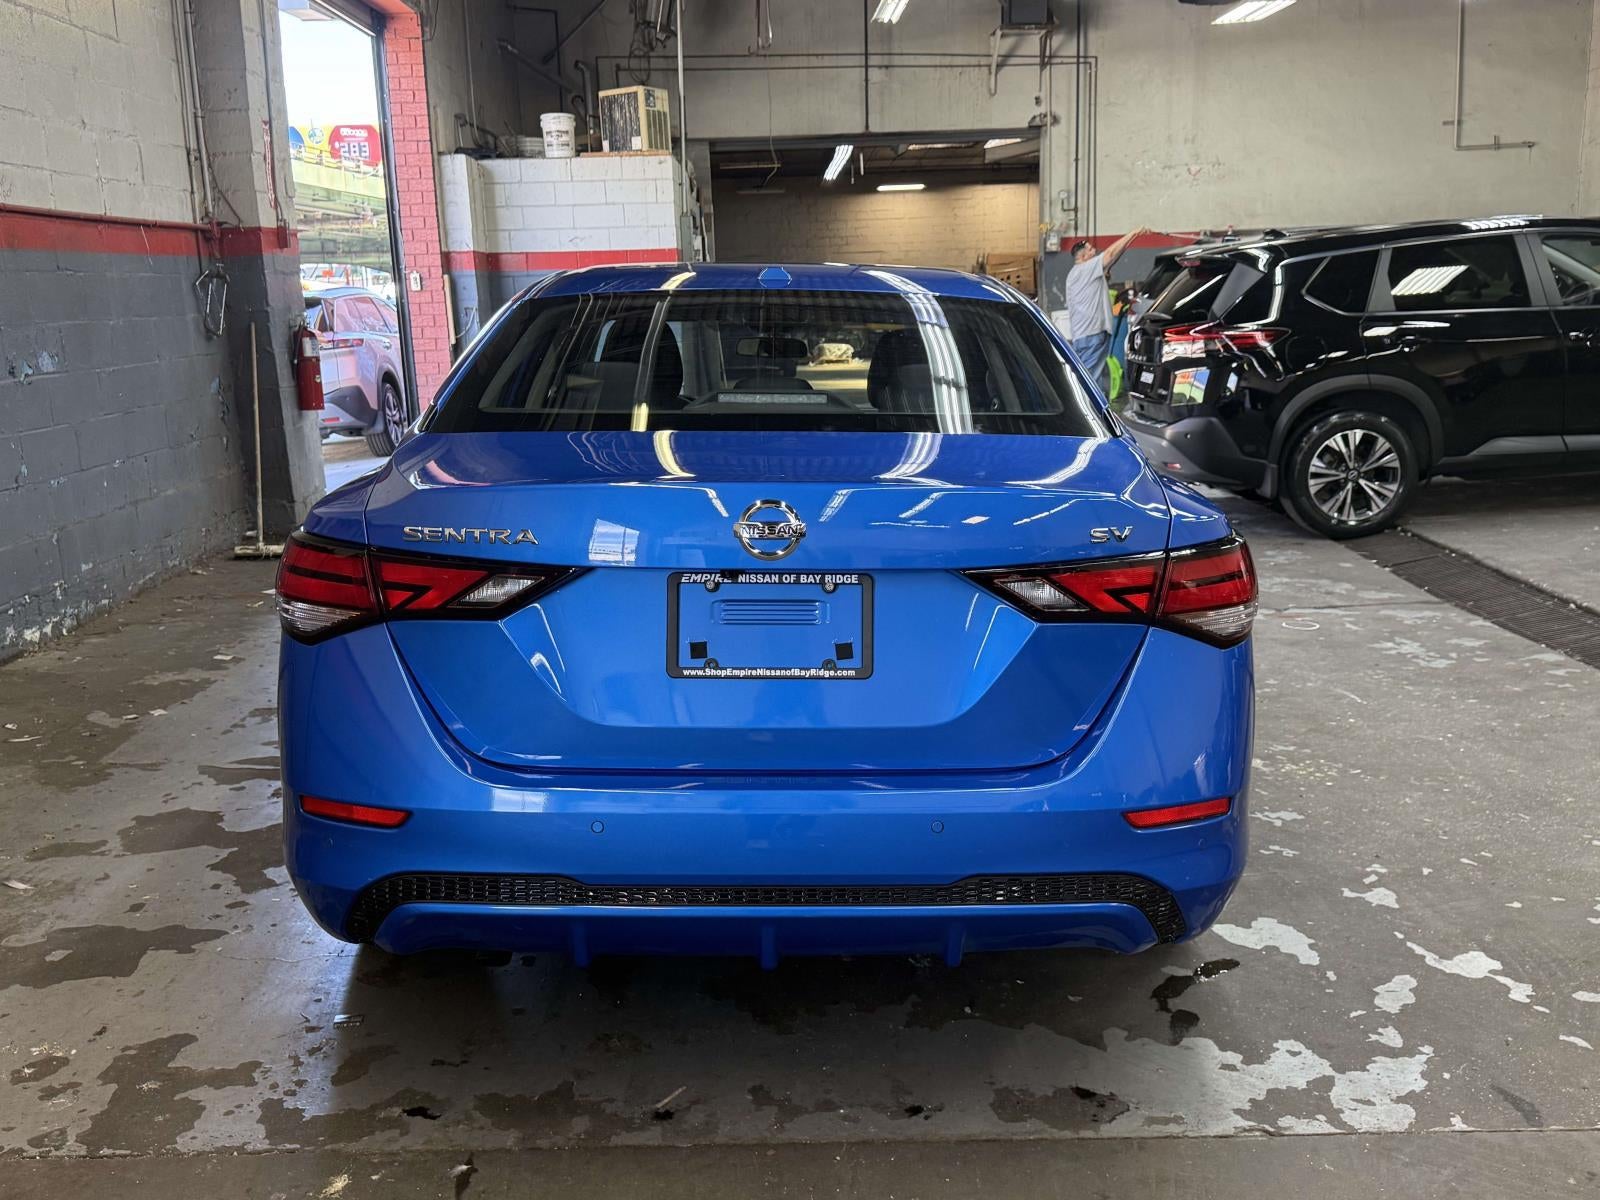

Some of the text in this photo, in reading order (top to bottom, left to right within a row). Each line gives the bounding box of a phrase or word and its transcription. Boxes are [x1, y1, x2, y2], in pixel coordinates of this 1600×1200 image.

[403, 526, 539, 545] SENTRA
[740, 525, 800, 536] NISSAN
[1090, 526, 1133, 543] SV
[738, 574, 780, 583] NISSAN
[782, 574, 797, 583] OF
[800, 574, 821, 583] BAY
[824, 574, 859, 584] RIDGE
[683, 667, 856, 678] www.ShopEmpireNissanofBayRidge.com
